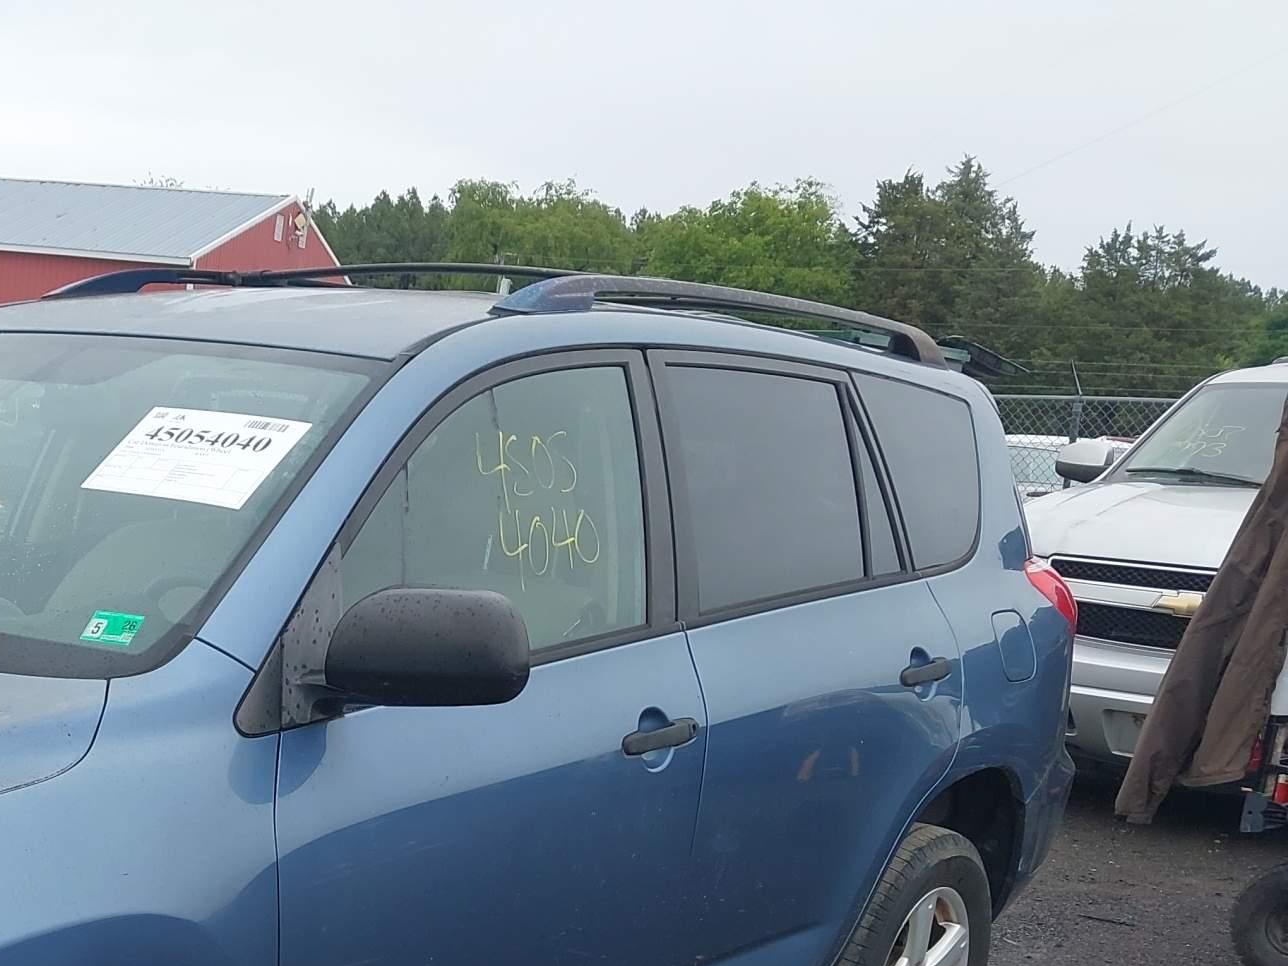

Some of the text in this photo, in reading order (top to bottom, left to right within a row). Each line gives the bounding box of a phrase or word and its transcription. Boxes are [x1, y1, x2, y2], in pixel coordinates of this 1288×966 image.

[144, 425, 272, 453] 45054040
[475, 430, 577, 514] 4505
[499, 505, 600, 592] 4040
[90, 621, 105, 635] 5
